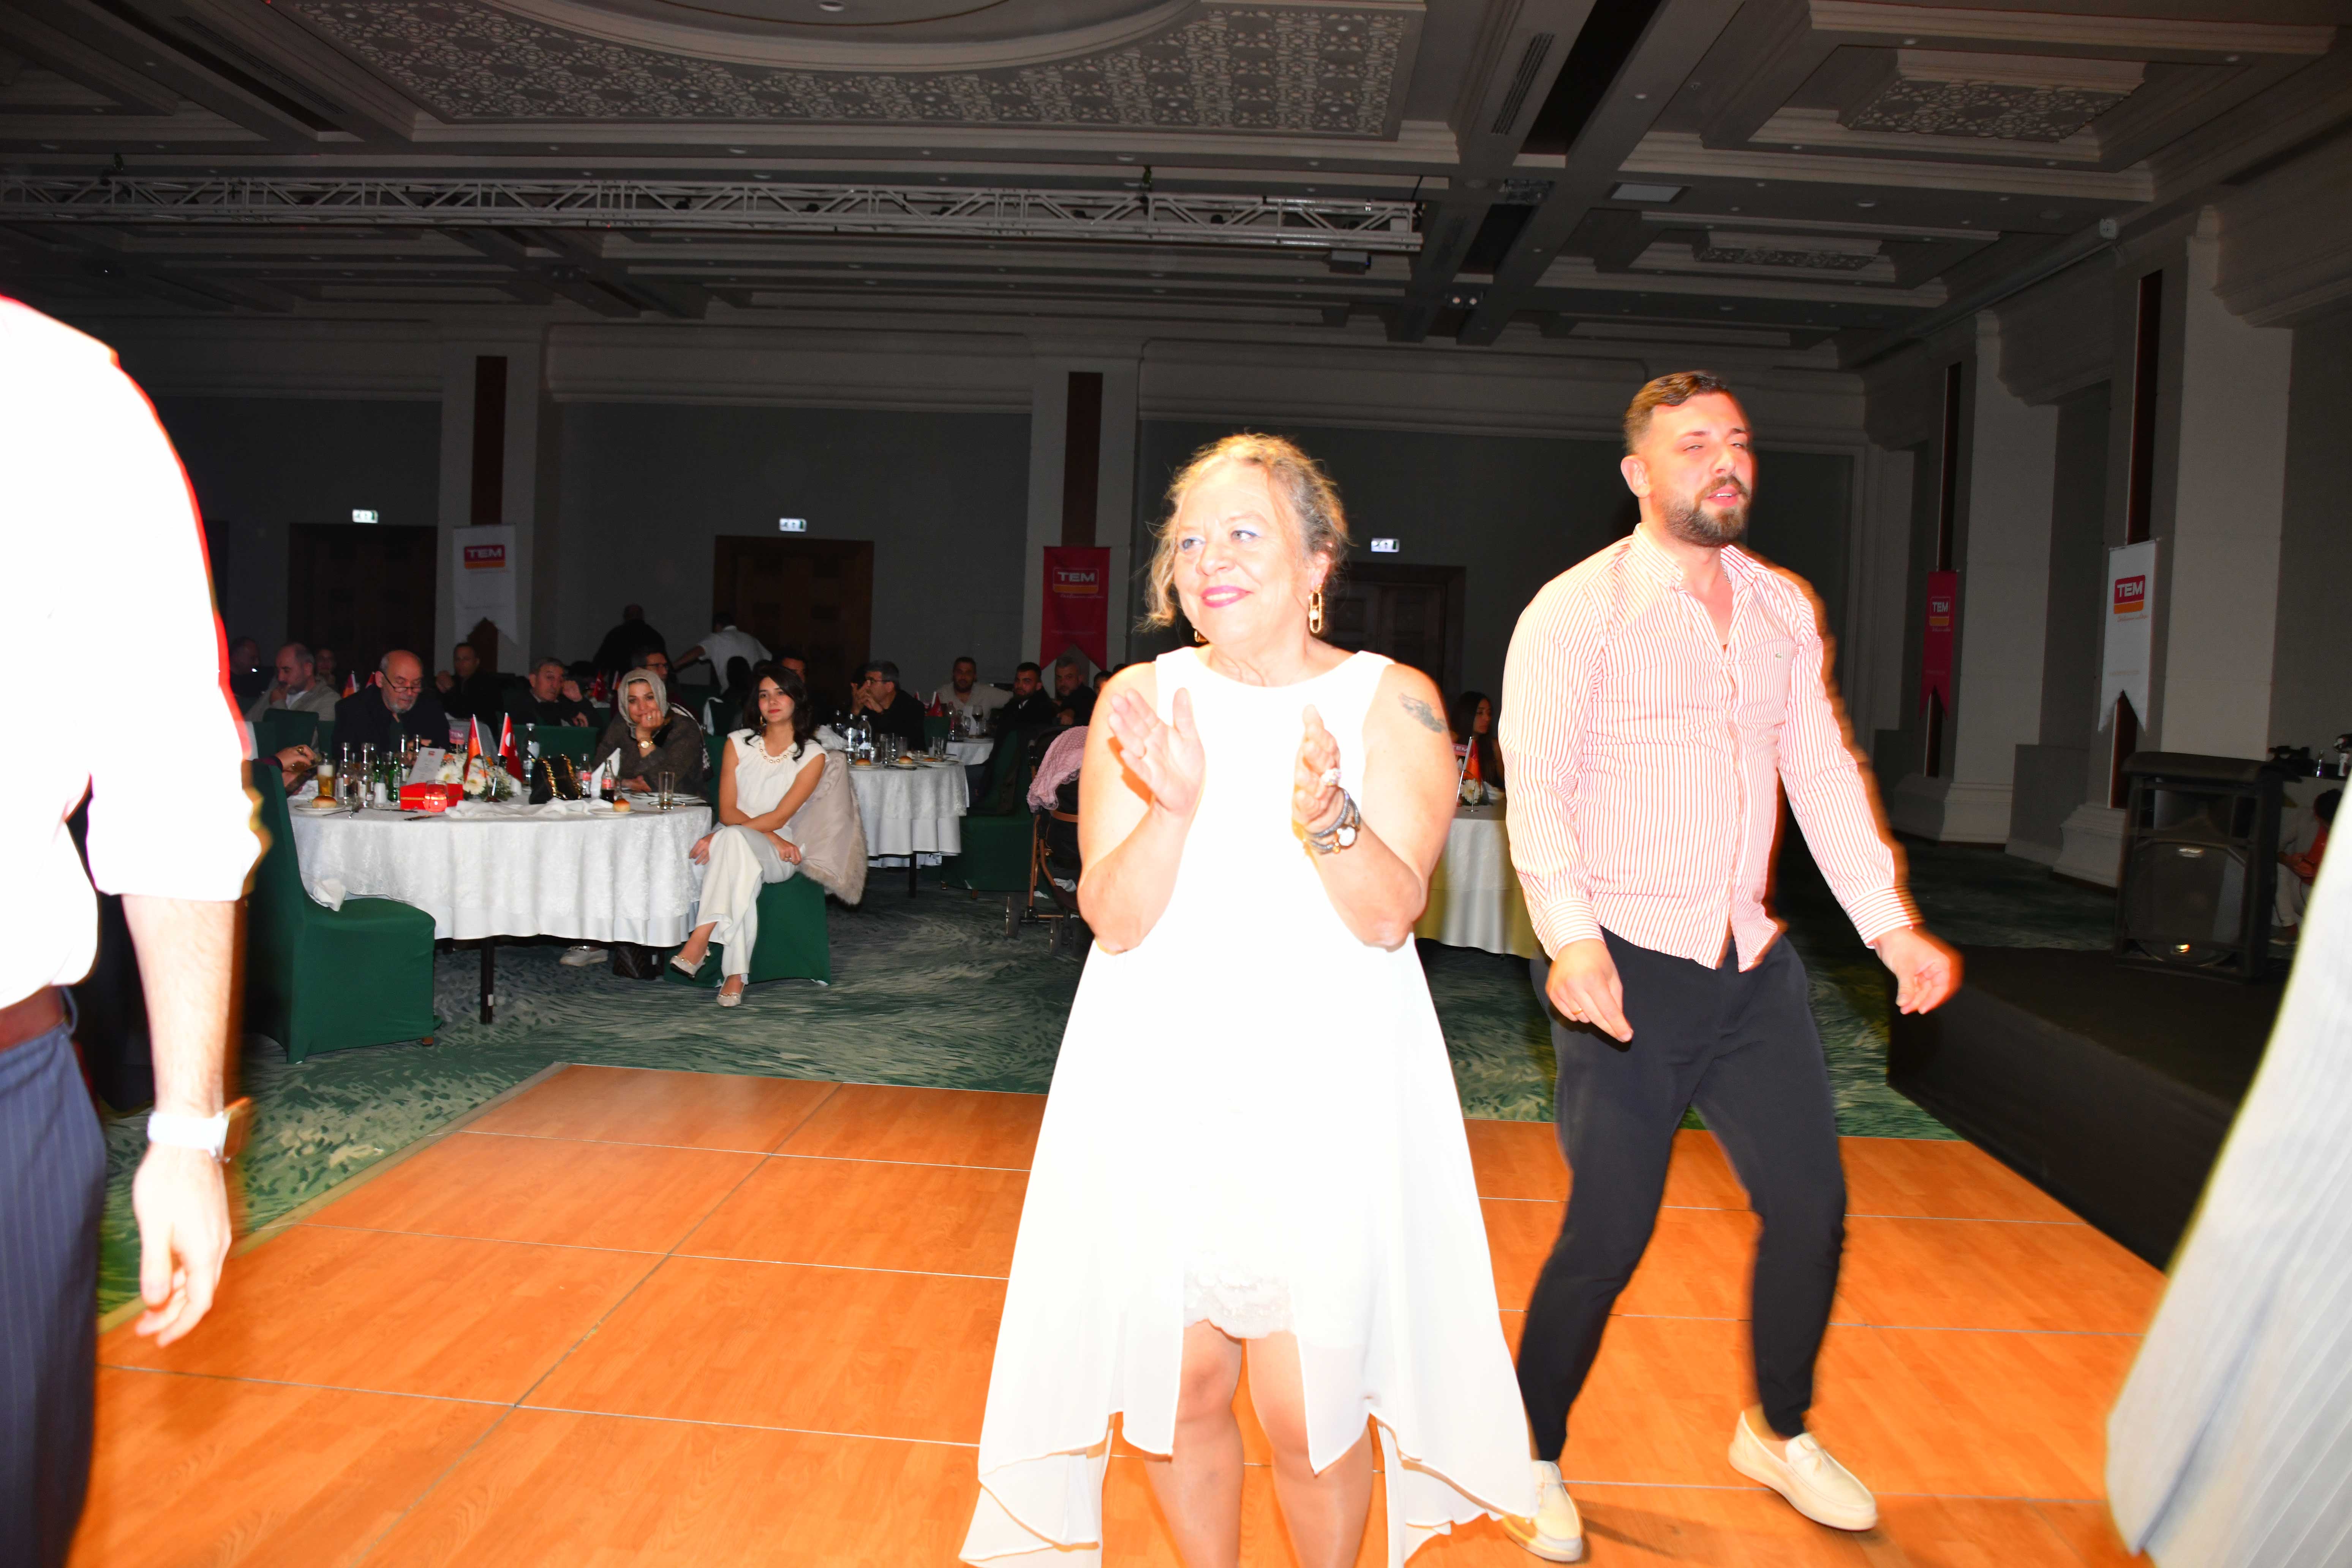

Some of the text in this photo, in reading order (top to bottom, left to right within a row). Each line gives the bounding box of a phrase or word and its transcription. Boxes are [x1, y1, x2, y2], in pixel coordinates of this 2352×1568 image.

[467, 547, 503, 559] TEM
[1057, 571, 1095, 582] TEM
[2116, 581, 2143, 598] TEM
[1932, 601, 1949, 613] TEM
